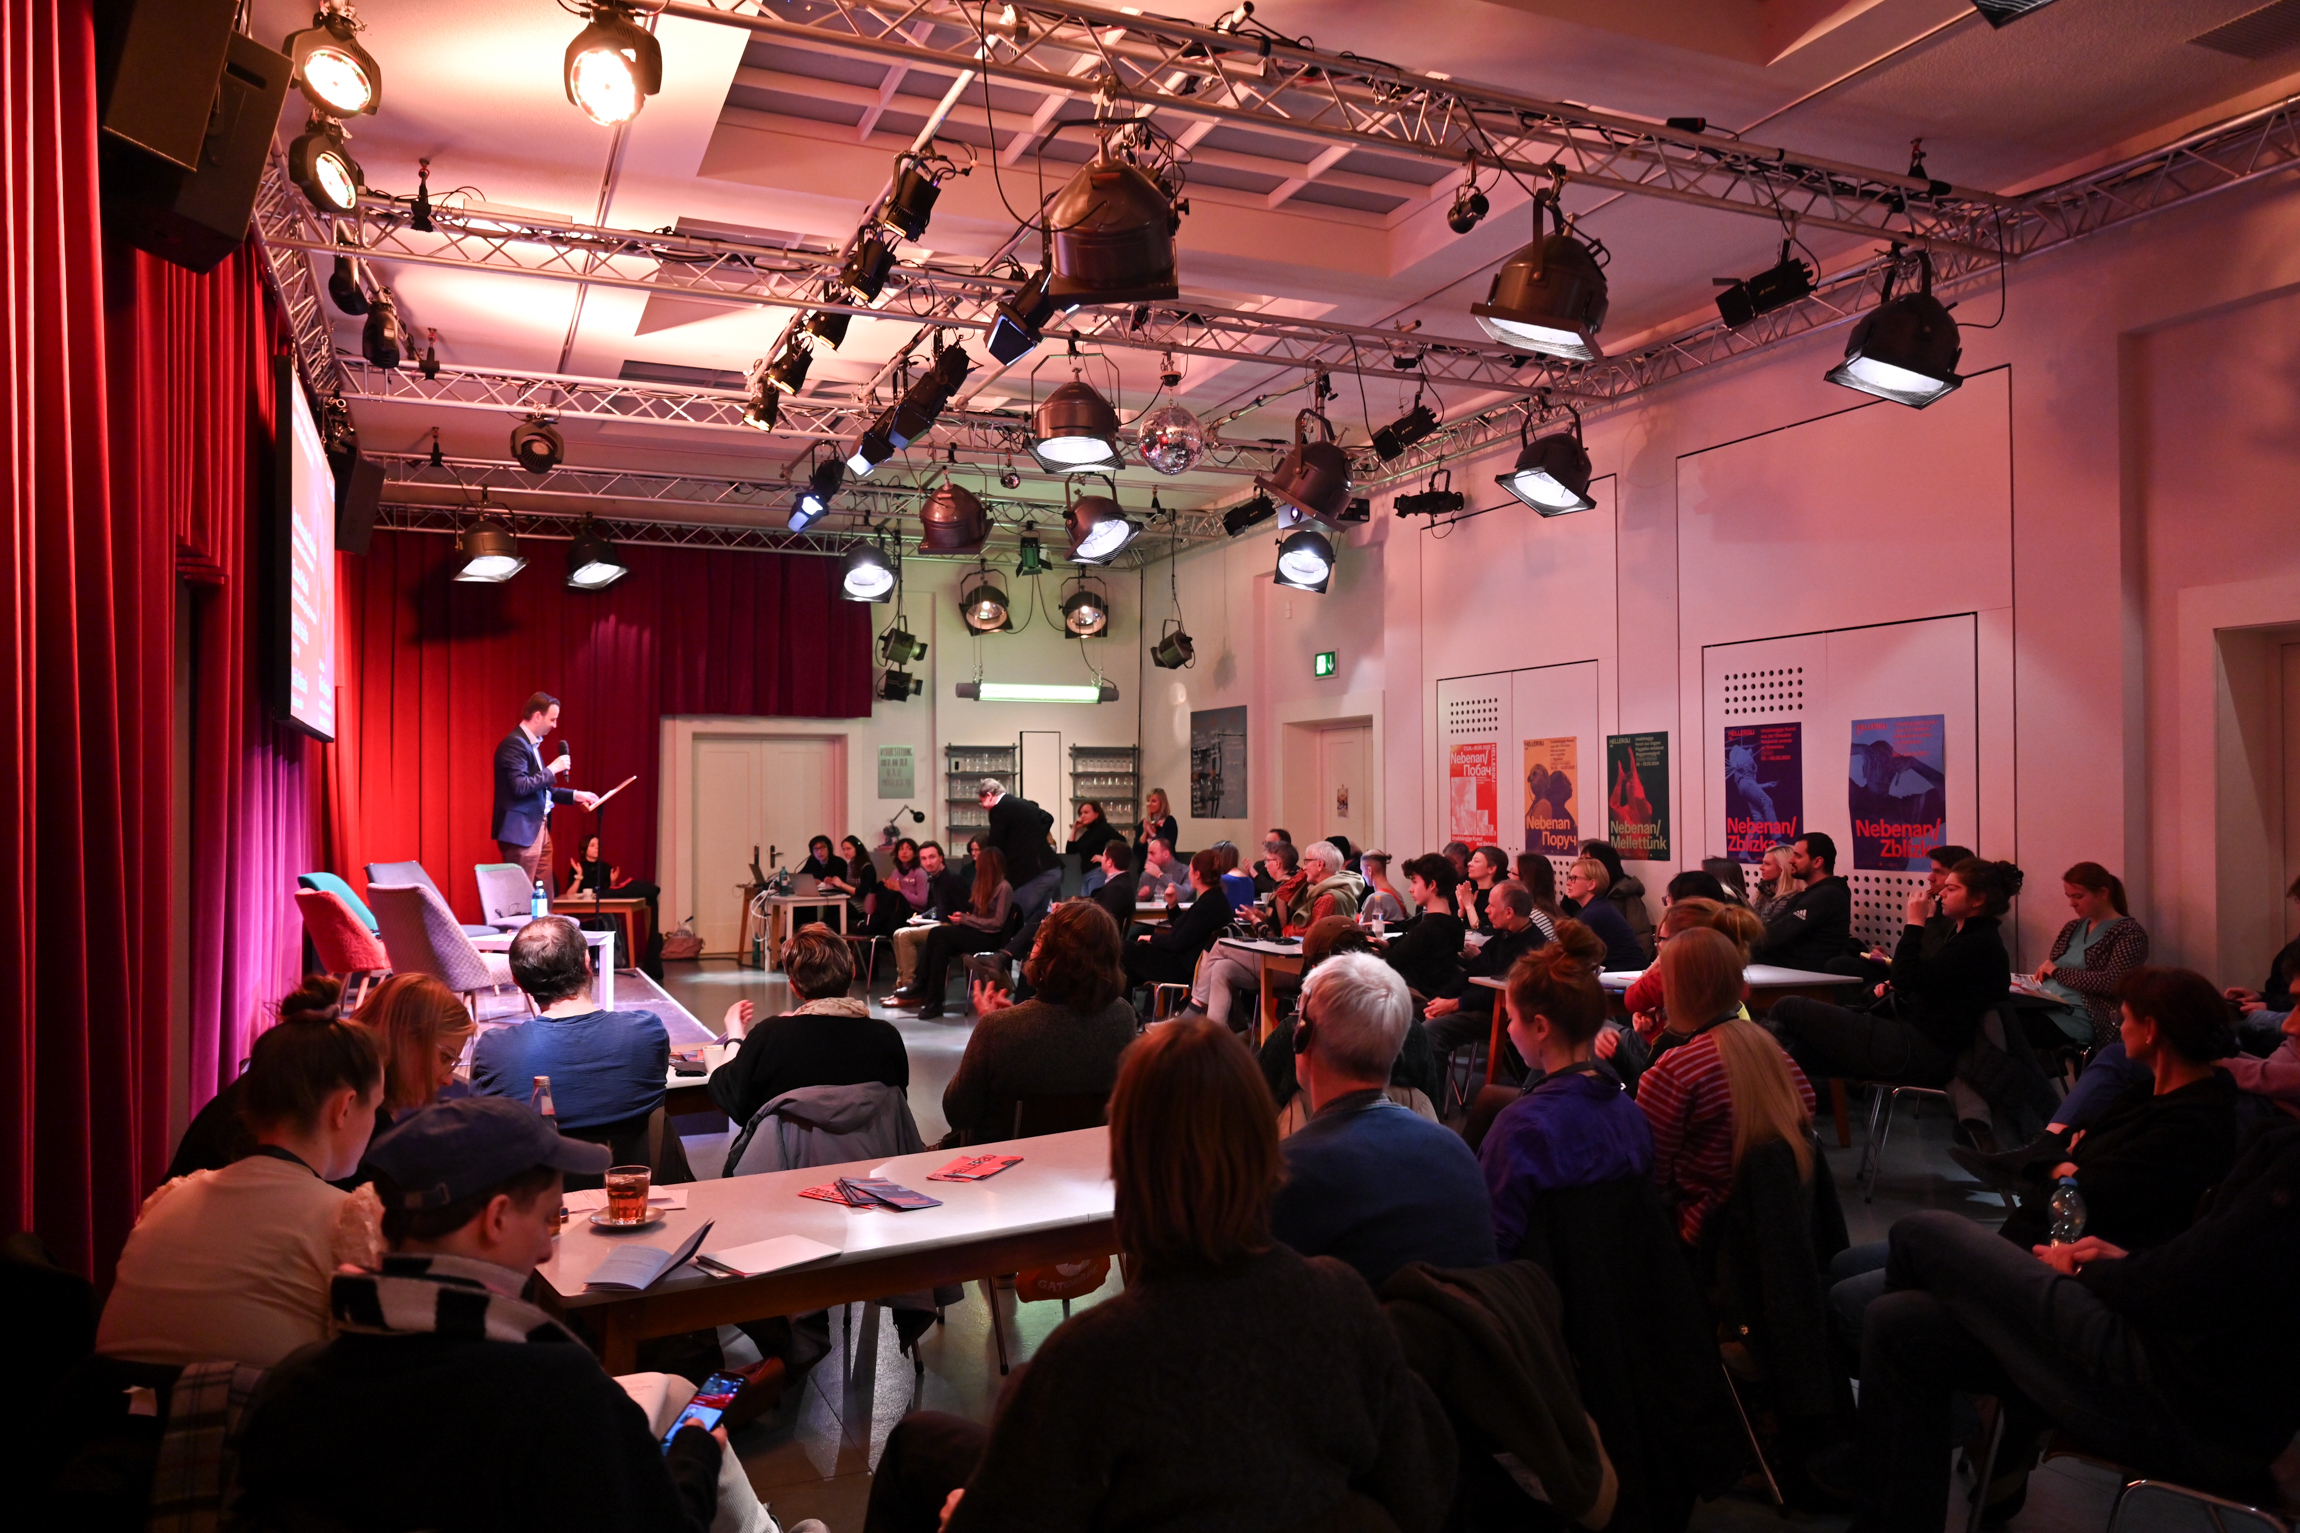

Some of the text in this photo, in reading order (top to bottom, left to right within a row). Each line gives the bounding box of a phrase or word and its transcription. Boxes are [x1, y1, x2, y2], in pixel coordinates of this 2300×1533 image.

[1450, 750, 1489, 765] Nebenan/
[1463, 763, 1491, 777] Побач
[1526, 815, 1571, 830] Nebenan
[1610, 819, 1662, 837] Nebenan/
[1727, 816, 1797, 838] Nebenan/
[1855, 818, 1942, 842] Nebenan/
[1542, 831, 1577, 850] Поруч
[1610, 835, 1667, 850] Mellettünk
[1880, 839, 1941, 858] Zblízk
